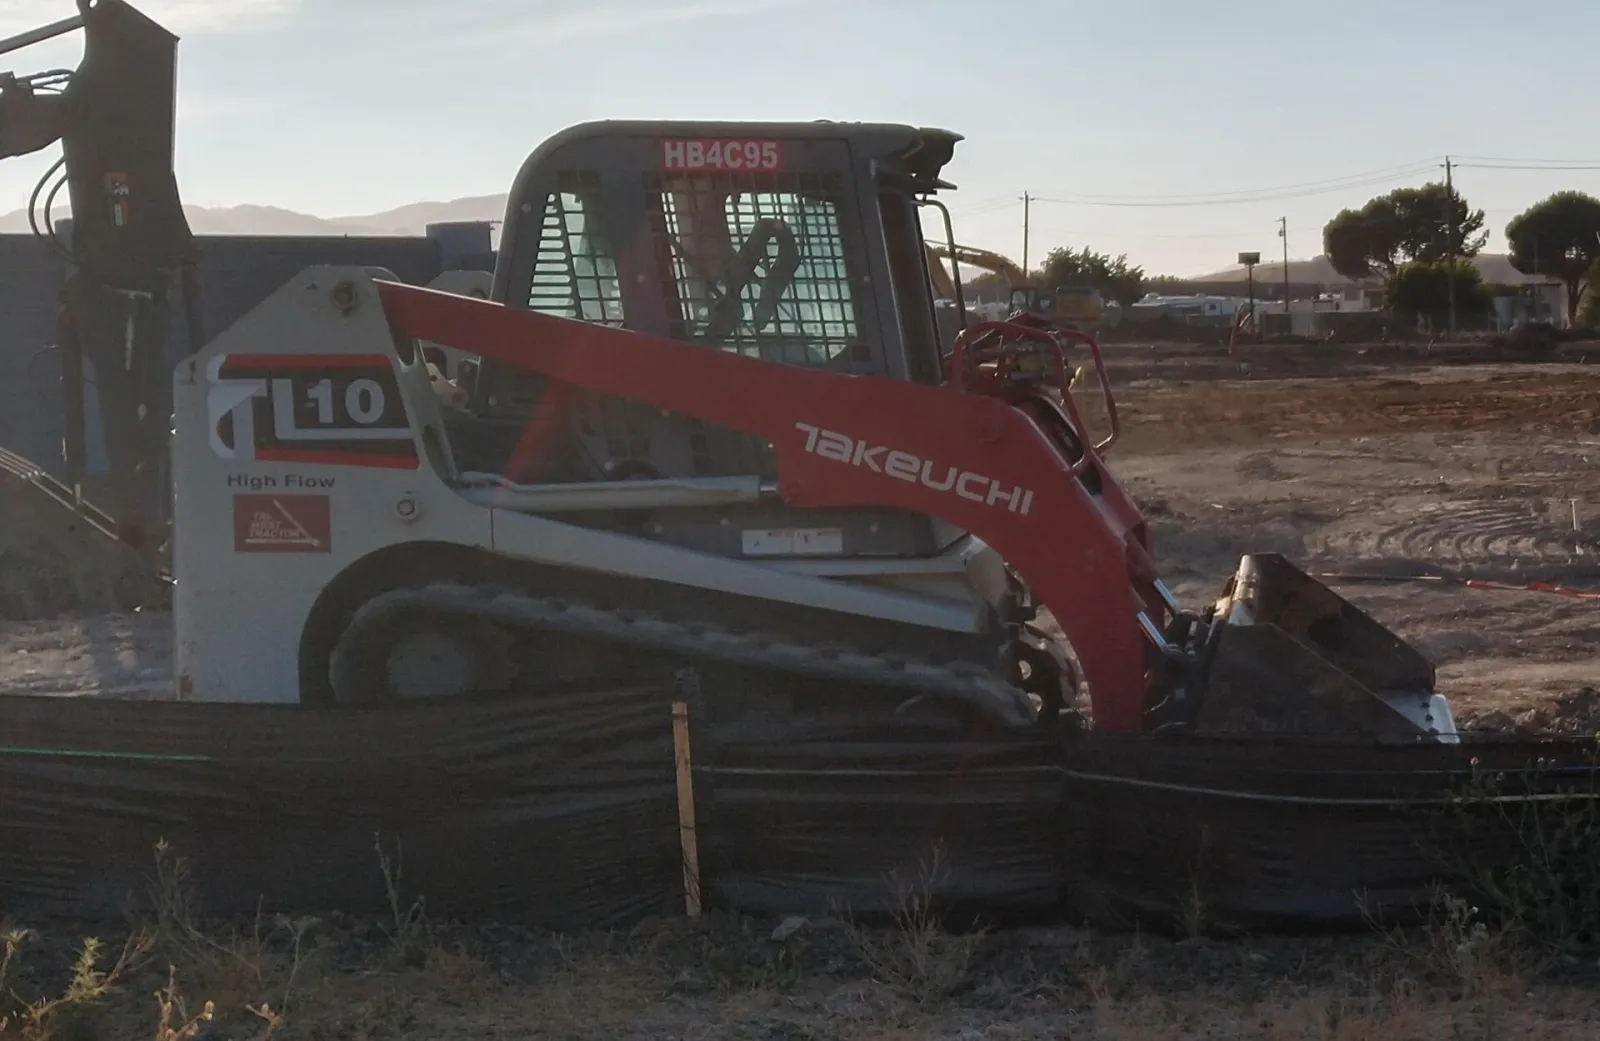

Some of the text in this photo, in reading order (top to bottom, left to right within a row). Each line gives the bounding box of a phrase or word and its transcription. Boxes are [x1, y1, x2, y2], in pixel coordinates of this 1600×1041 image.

[664, 141, 778, 168] HB4C95
[227, 474, 336, 490] High Flow
